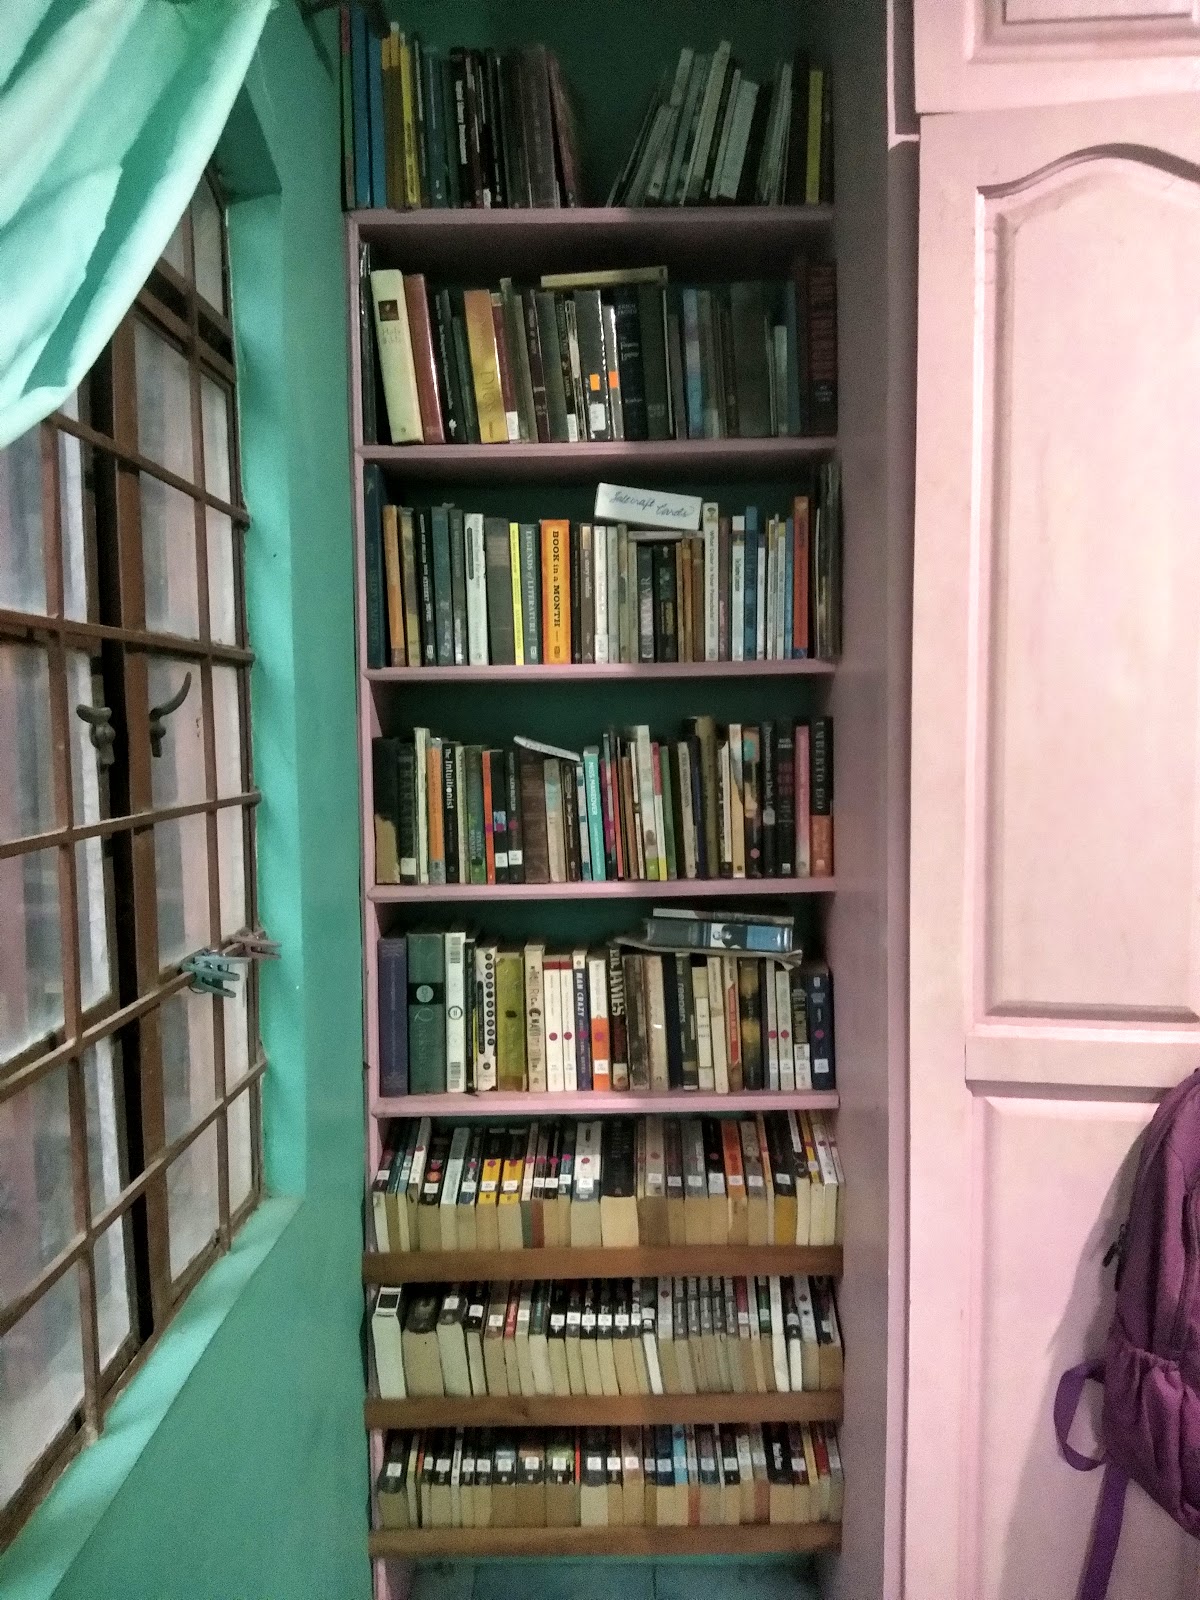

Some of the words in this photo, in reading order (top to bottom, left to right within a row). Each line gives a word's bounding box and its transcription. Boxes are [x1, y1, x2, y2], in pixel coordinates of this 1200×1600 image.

[552, 530, 560, 562] BOOK
[553, 564, 560, 574] in
[527, 580, 536, 633] LITERATURE
[553, 584, 561, 628] MONTH
[641, 577, 654, 659] GRAMMAR
[815, 721, 825, 783] UMBERTO
[445, 760, 454, 809] Intuitionist
[590, 779, 598, 816] MAKEOVER
[815, 787, 825, 810] ECO
[576, 992, 585, 1017] CRAZY
[610, 969, 625, 1016] JAMES
[678, 982, 687, 1023] reapers
